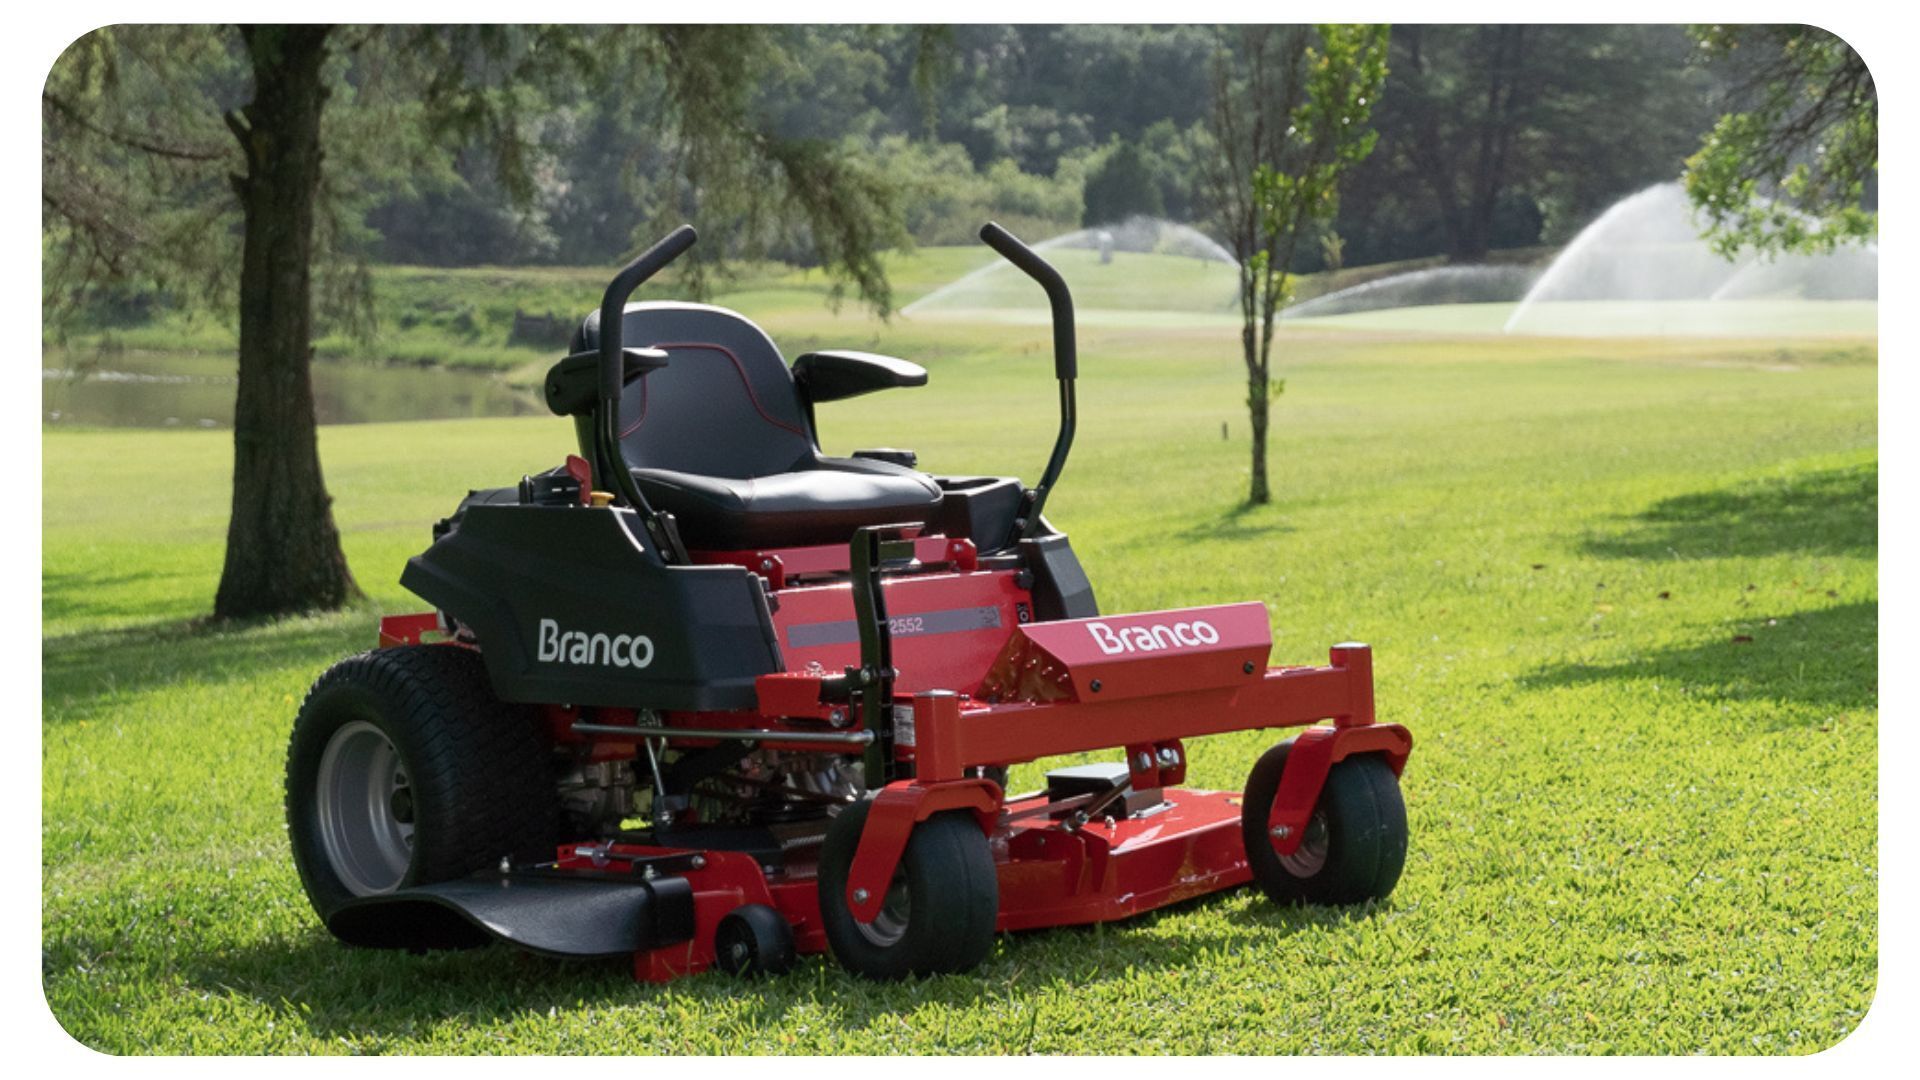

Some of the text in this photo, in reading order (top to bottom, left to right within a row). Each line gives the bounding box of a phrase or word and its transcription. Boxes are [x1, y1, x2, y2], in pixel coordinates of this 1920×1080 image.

[889, 616, 924, 635] 2552
[1086, 620, 1220, 655] Branco
[538, 618, 655, 669] Branco
